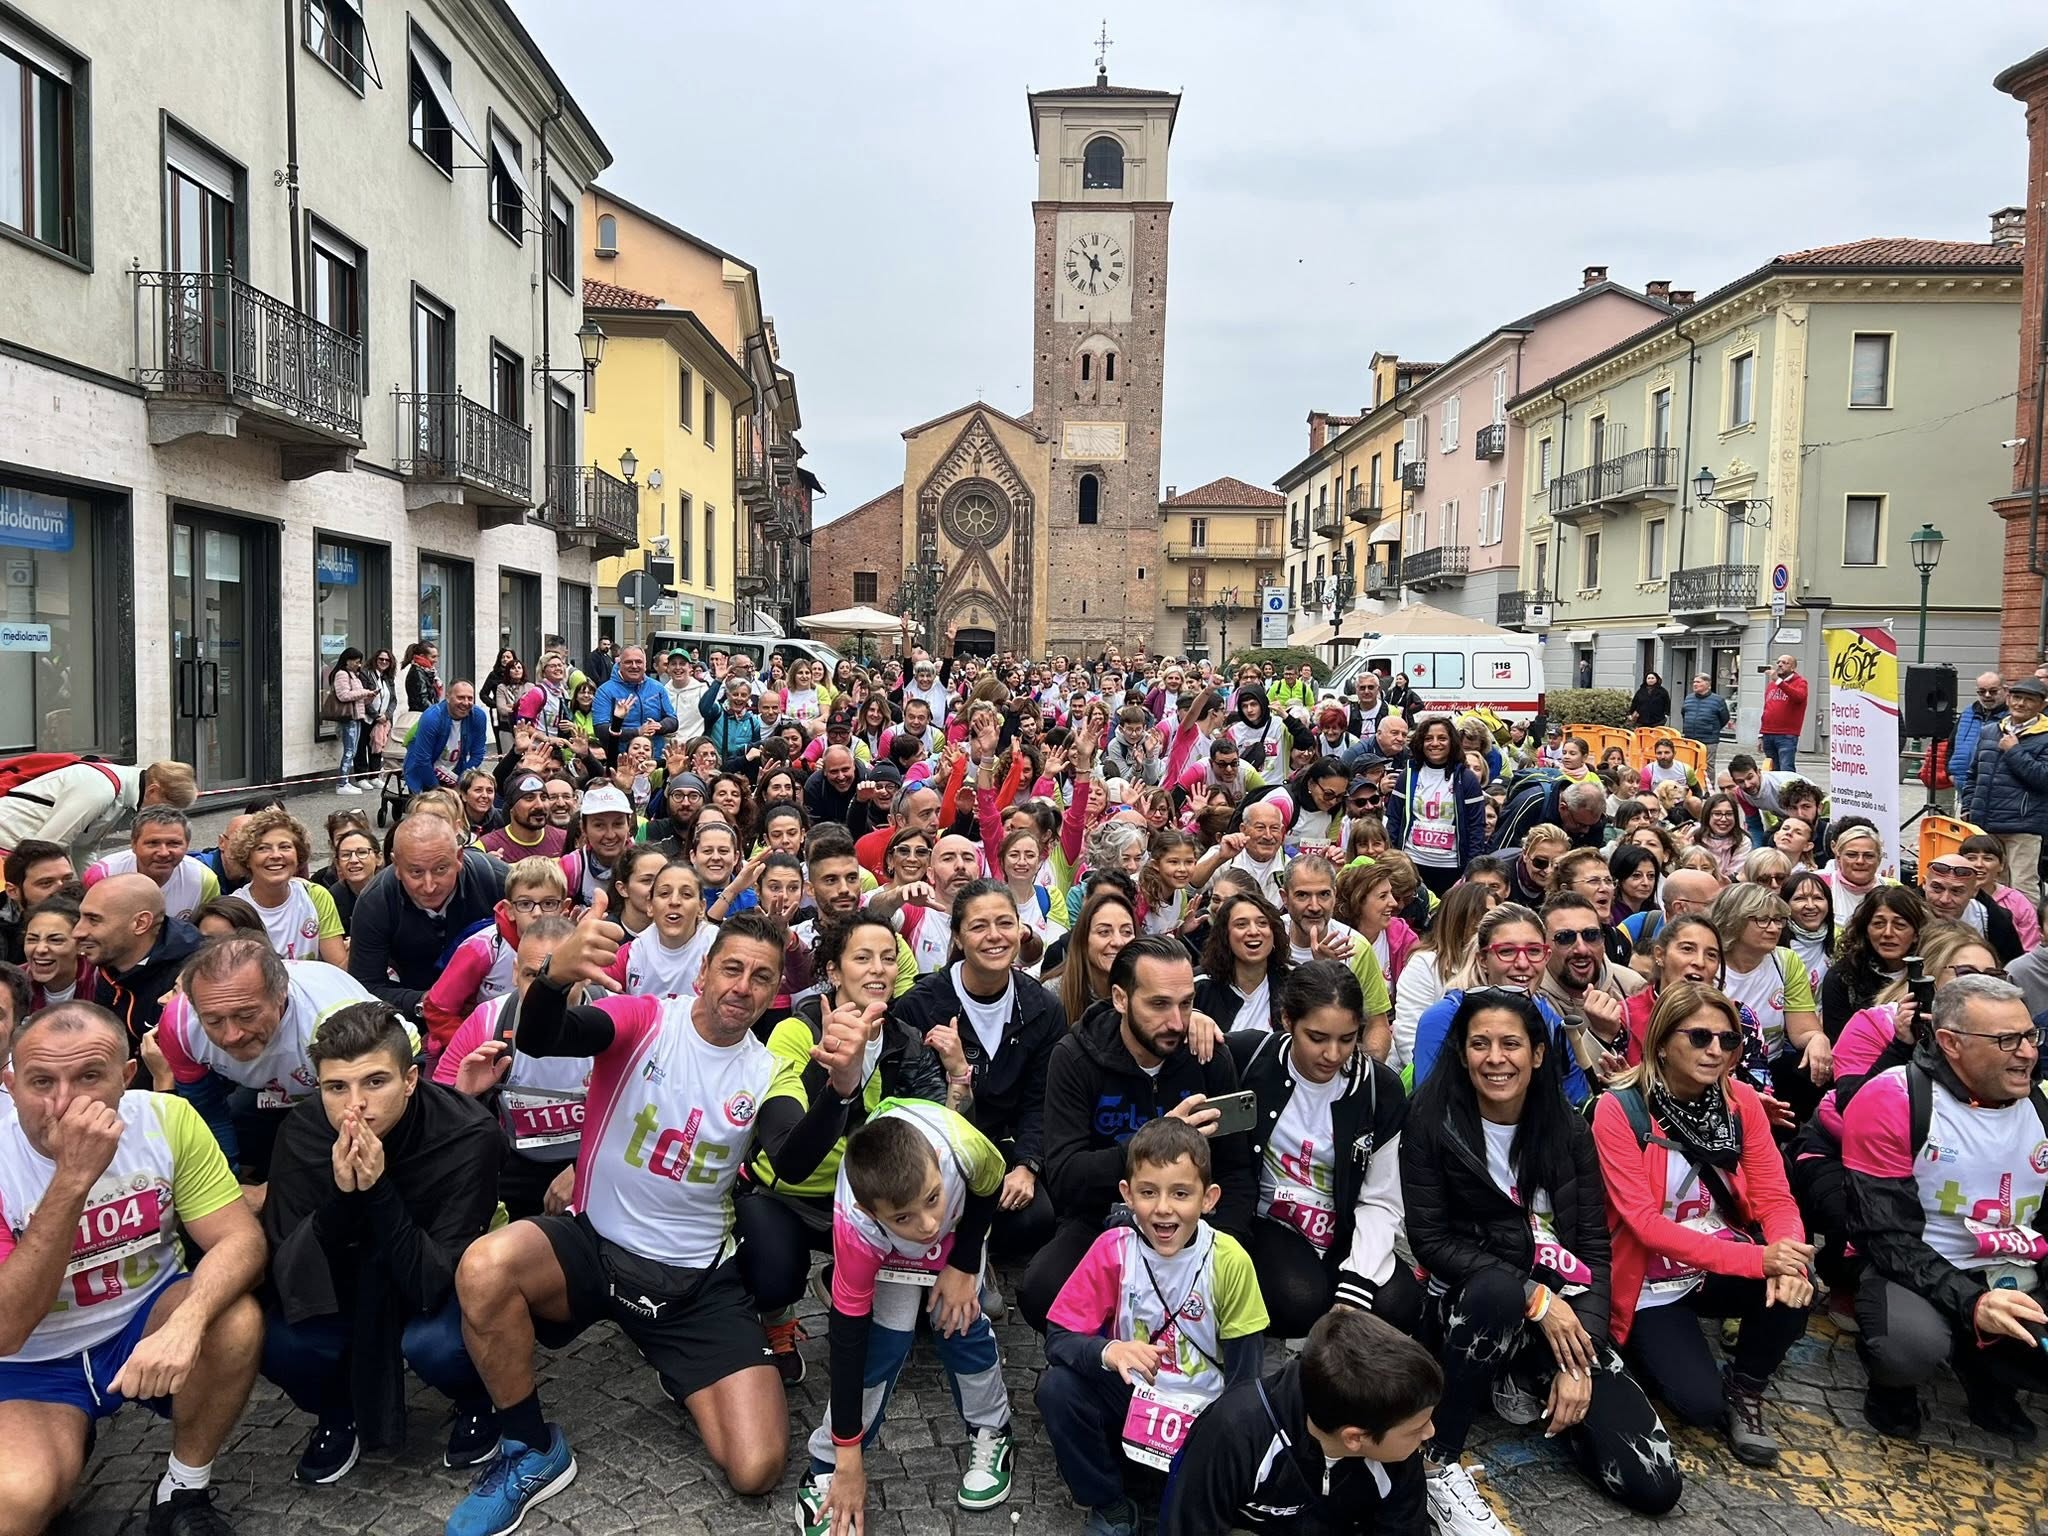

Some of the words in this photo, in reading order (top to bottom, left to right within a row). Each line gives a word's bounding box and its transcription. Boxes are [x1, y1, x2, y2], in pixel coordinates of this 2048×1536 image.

[3, 630, 49, 642] mediolanum
[1494, 661, 1511, 670] 118
[1832, 650, 1882, 682] HOPE
[1424, 701, 1447, 711] Croce
[1831, 702, 1860, 719] Perché
[1831, 721, 1866, 738] nsieme
[1839, 740, 1865, 757] vince.
[1831, 756, 1868, 777] Sempre.
[1418, 830, 1449, 845] 1075
[523, 1104, 585, 1128] 1116
[624, 1103, 731, 1185] tdc
[78, 1199, 144, 1244] 104
[1137, 1388, 1156, 1401] tdc
